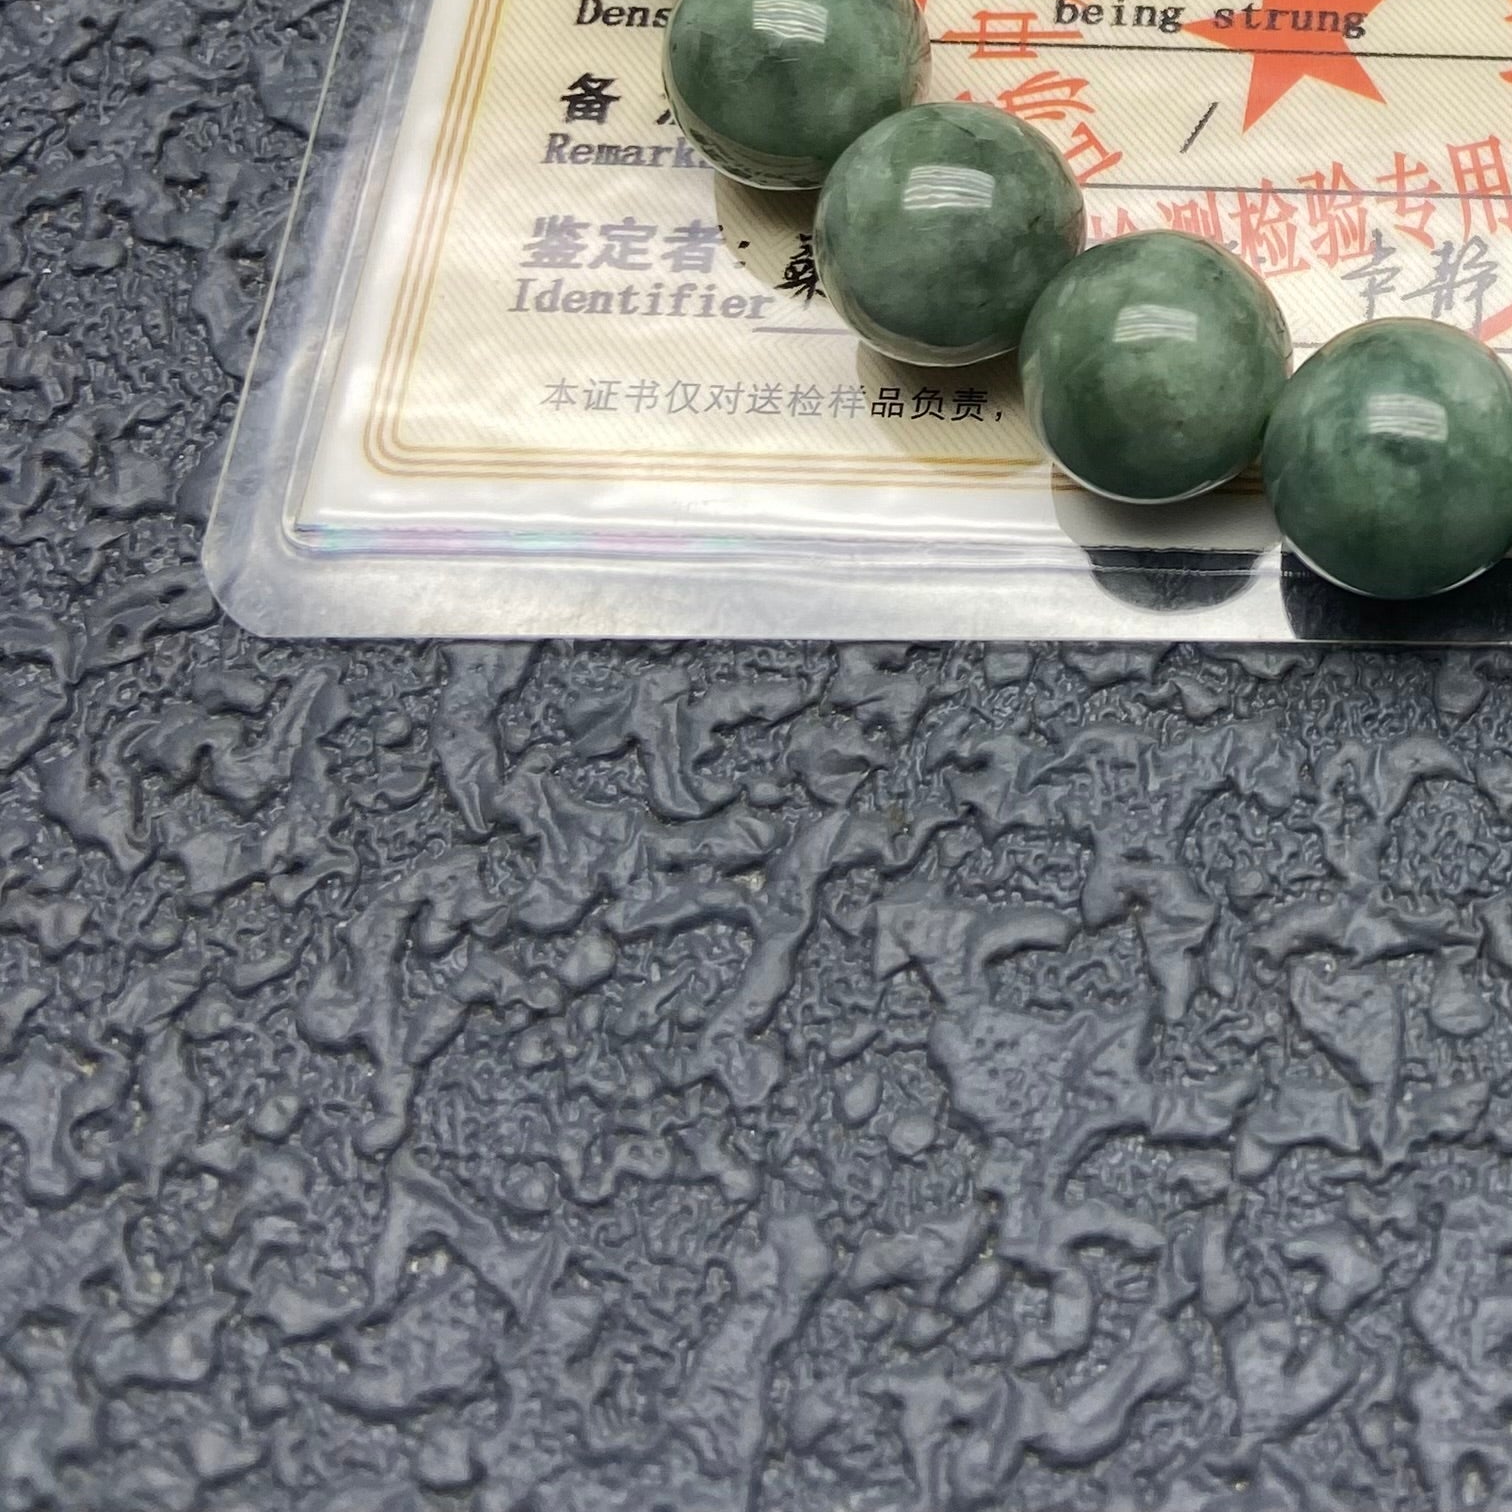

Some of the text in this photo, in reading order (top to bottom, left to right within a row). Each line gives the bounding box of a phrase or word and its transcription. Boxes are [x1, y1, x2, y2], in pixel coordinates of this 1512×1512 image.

[1213, 1, 1367, 39] strung
[540, 132, 712, 169] Remark
[507, 277, 776, 321] Identifier
